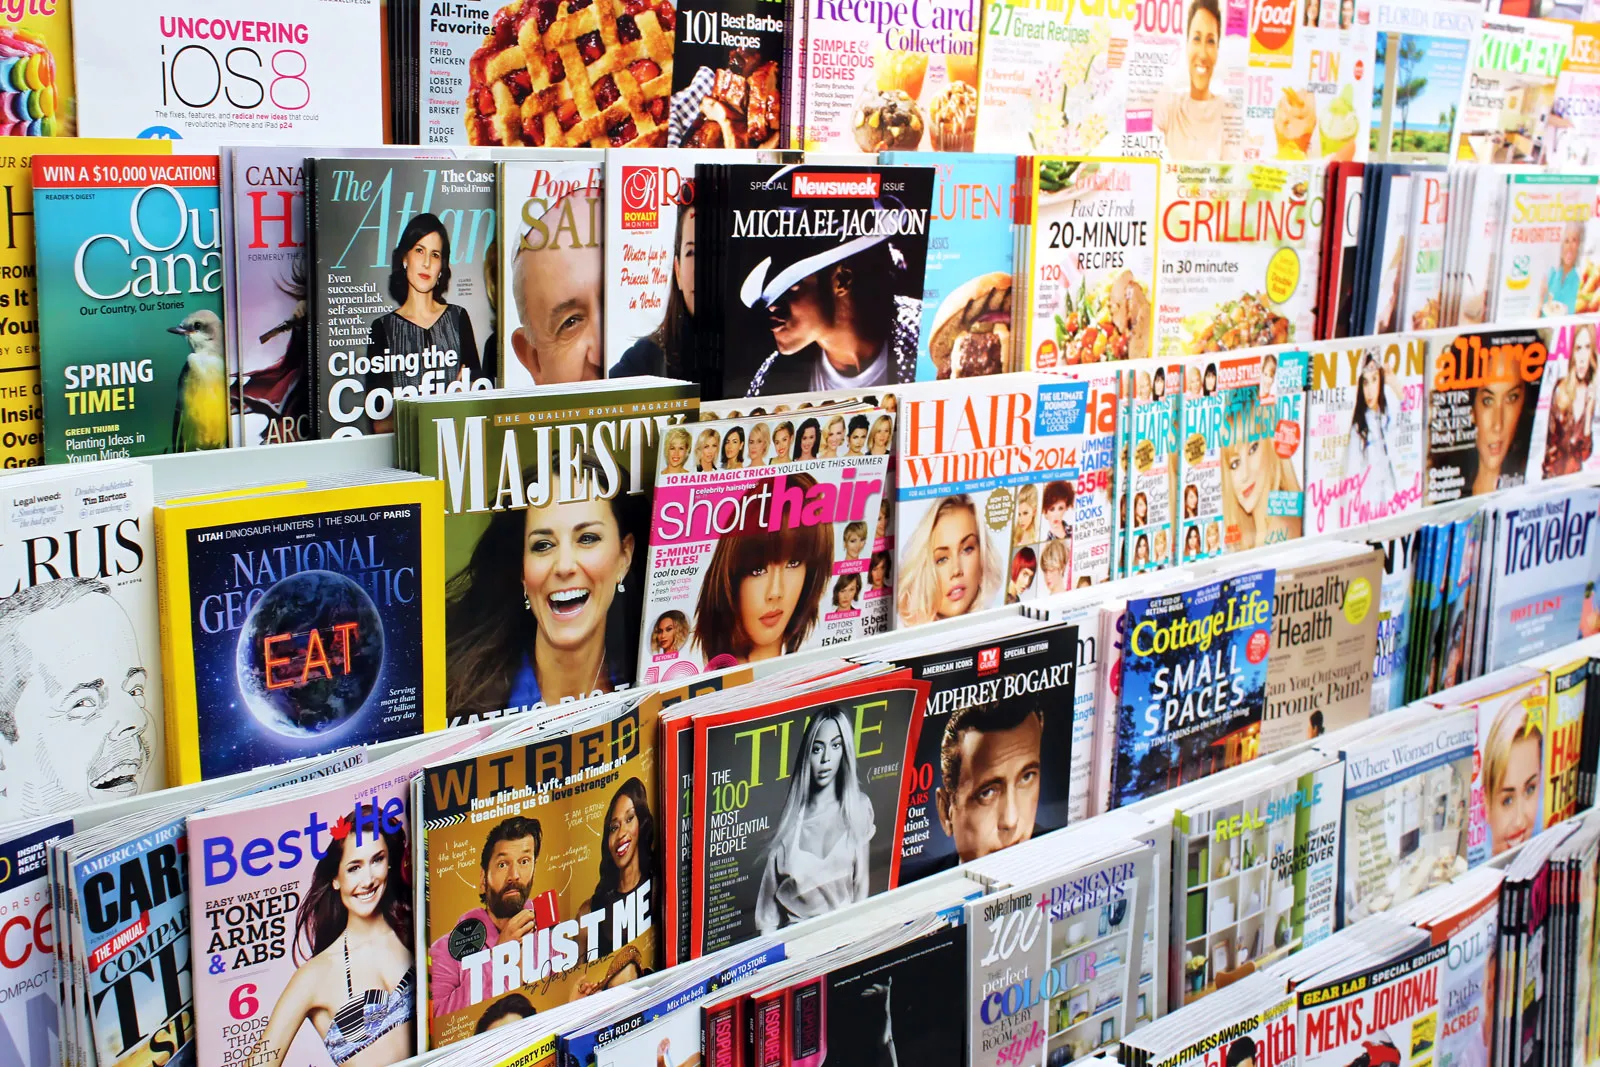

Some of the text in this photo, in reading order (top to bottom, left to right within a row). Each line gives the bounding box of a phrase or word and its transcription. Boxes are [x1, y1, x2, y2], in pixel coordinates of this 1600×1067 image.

[430, 4, 489, 19] All-Time
[430, 18, 497, 36] Favorites
[912, 0, 974, 32] Card
[989, 4, 1090, 44] 27 Great Recipes
[160, 16, 309, 44] UNCOVERING
[682, 10, 746, 45] 101 Best
[721, 32, 761, 50] Recipes
[885, 28, 974, 57] Collection
[812, 52, 874, 68] DELICIOUS
[813, 39, 856, 54] SIMPLE
[812, 67, 855, 81] DISHES
[155, 111, 168, 119] The
[218, 112, 231, 120] and
[232, 112, 254, 121] radical
[271, 113, 287, 121] ideas
[288, 113, 302, 121] that
[303, 114, 319, 122] could
[43, 165, 216, 183] WIN A $10,000 VACATION!
[331, 170, 372, 202] The
[441, 169, 495, 183] The Case
[750, 176, 905, 196] SPECIAL Newsweek ISSUE
[731, 208, 927, 243] MICHAEL JACKSON
[1049, 221, 1147, 249] 20-MINUTE
[1162, 200, 1306, 242] GRILLING
[1077, 251, 1124, 270] RECIPES
[1162, 260, 1239, 273] in 30 minutes
[327, 274, 351, 283] Even
[328, 283, 376, 294] successful
[80, 300, 185, 316] Our Country, Our Stories
[328, 293, 383, 304] women lack
[328, 304, 393, 315] self-assurance
[328, 326, 372, 336] Men have
[339, 315, 365, 325] work.
[329, 336, 375, 347] too much.
[64, 359, 153, 390] SPRING
[328, 345, 458, 377] Closing the
[1434, 335, 1547, 391] allure
[64, 387, 135, 416] TIME!
[497, 400, 689, 424] THE QUALITY ROYAL MAGAZINE
[906, 393, 1036, 457] HAIR
[432, 413, 687, 515] MAJEST
[666, 457, 883, 485] 10 HAIR MAGIC TRICKS YOU'LL LOVE THIS SUMMER
[1035, 447, 1076, 471] 2014
[198, 519, 314, 542] UTAH DINOSAUR HUNTERS
[325, 509, 411, 526] THE SOUL OF PARIS
[656, 544, 711, 558] 5-MINUTE
[1505, 498, 1596, 576] Traveler
[231, 535, 384, 587] NATIONAL
[654, 555, 699, 568] STYLES!
[1130, 590, 1269, 656] Cottage Life
[1277, 612, 1332, 649] Health
[263, 622, 358, 690] EAT
[980, 659, 998, 669] GUIDE
[982, 651, 997, 661] TV
[1004, 642, 1048, 658] SPECIAL EDITION
[922, 659, 973, 675] AMERICAN ICONS
[1003, 662, 1073, 700] BOGART
[1152, 645, 1242, 701] SMALL
[1143, 675, 1246, 737] SPACES
[735, 700, 888, 788] TIE
[1349, 756, 1391, 781] Where
[1391, 741, 1434, 767] Women
[1436, 728, 1474, 750] Create
[429, 716, 640, 814] WIRED
[712, 769, 731, 784] THE
[471, 754, 627, 811] How Airbnb, Lyft, and Tinder are
[471, 771, 620, 824] teaching us to love strangers
[712, 780, 750, 815] 100
[711, 810, 740, 828] MOST
[1215, 783, 1323, 843] REAL SIMPLE
[710, 816, 770, 843] INFLUENTIAL
[203, 812, 328, 887] Best
[710, 837, 747, 857] PEOPLE
[1271, 830, 1335, 871] ORGANIZING
[1277, 846, 1334, 882] MAKEOVER
[1050, 861, 1135, 902] DESIGNER
[206, 892, 299, 931] TONED
[1050, 882, 1124, 924] SECRETS
[206, 917, 286, 954] ARMS
[462, 880, 651, 1005] TRUST ME
[980, 908, 1045, 968] 100
[208, 939, 286, 975] & ABS
[980, 950, 1098, 1026] COLOUR
[982, 964, 1028, 1000] perfect
[1303, 946, 1447, 1005] GEAR LAB SPECIAL EDITION
[1305, 966, 1439, 1056] MEN'S JOURNAL
[1179, 1014, 1259, 1063] FITNESS AWARDS
